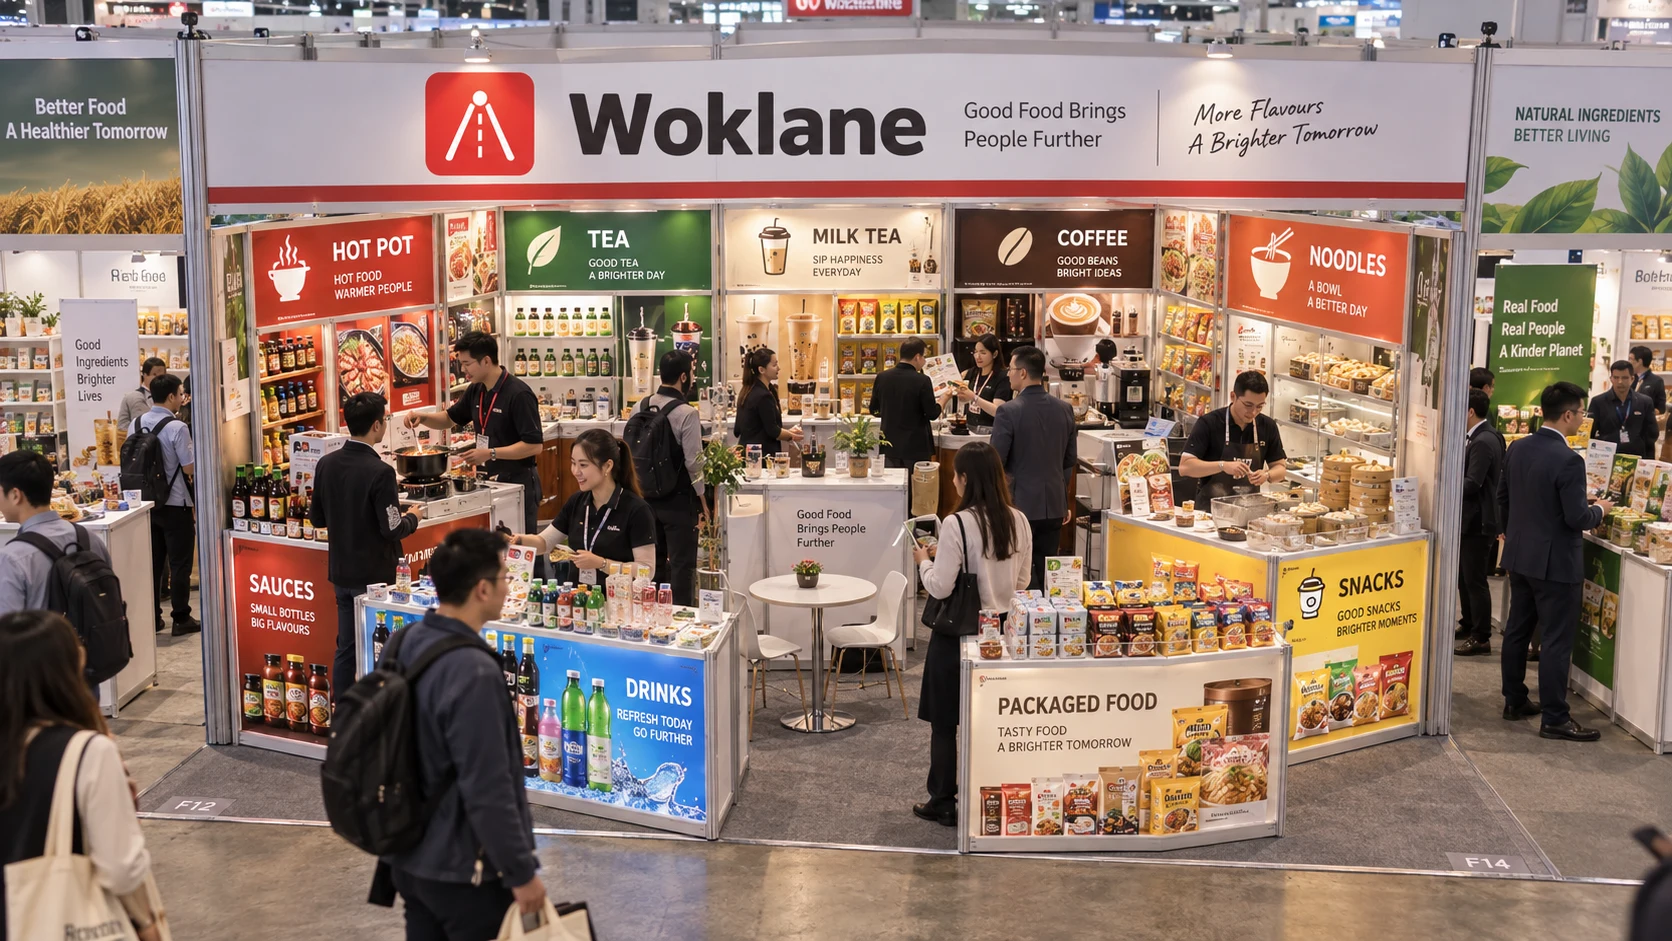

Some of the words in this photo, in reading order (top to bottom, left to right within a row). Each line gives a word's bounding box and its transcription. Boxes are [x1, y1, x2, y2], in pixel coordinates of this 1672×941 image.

[36, 98, 84, 114] Better
[89, 98, 126, 115] Food
[965, 102, 1012, 118] Good
[1020, 102, 1062, 118] Food
[1070, 102, 1126, 123] Brings
[1194, 103, 1242, 126] More
[1251, 98, 1323, 121] Flavours
[1516, 107, 1574, 121] NATURAL
[1578, 108, 1660, 123] INGREDIENTS
[6, 123, 17, 139] A
[21, 122, 89, 139] Healthier
[93, 123, 167, 139] Tomorrow
[569, 92, 926, 156] Woklane
[965, 130, 1027, 151] People
[1034, 130, 1102, 147] Further
[1188, 134, 1203, 154] A
[1210, 128, 1287, 157] Brighter
[1293, 123, 1378, 144] Tomorrow
[1514, 128, 1563, 142] BETTER
[1568, 129, 1610, 142] LIVING
[588, 230, 630, 248] TEA
[814, 228, 858, 244] MILK
[865, 228, 901, 244] TEA
[1058, 230, 1127, 246] COFFEE
[333, 239, 371, 261] HOT
[377, 235, 413, 257] POT
[589, 259, 617, 268] GOOD
[620, 259, 638, 268] TEA
[813, 255, 827, 264] SIP
[831, 255, 883, 264] HAPPINESS
[1057, 256, 1085, 266] GOOD
[1088, 256, 1118, 266] BEANS
[1310, 245, 1386, 277] NOODLES
[334, 273, 353, 285] HOT
[357, 270, 382, 282] FOOD
[589, 272, 596, 280] A
[599, 271, 644, 280] BRIGHTER
[647, 271, 665, 280] DAY
[813, 268, 861, 277] EVERYDAY
[1057, 269, 1092, 278] BRIGHT
[1095, 269, 1121, 278] IDEAS
[335, 285, 375, 299] WARMER
[378, 281, 412, 294] PEOPLE
[1308, 280, 1314, 291] A
[1317, 282, 1342, 296] BOWL
[1307, 297, 1313, 308] A
[1316, 298, 1347, 314] BETTER
[1350, 304, 1367, 317] DAY
[1503, 300, 1527, 313] Real
[1531, 299, 1558, 313] Food
[1502, 322, 1525, 335] Real
[1529, 321, 1565, 338] People
[75, 339, 100, 350] Good
[1499, 345, 1508, 358] A
[1511, 344, 1546, 357] Kinder
[1549, 343, 1583, 356] Planet
[76, 356, 128, 370] Ingredients
[77, 373, 115, 387] Brighter
[78, 391, 102, 402] Lives
[797, 509, 823, 519] Good
[827, 510, 851, 519] Food
[798, 524, 829, 535] Brings
[832, 524, 866, 535] People
[798, 538, 834, 548] Further
[250, 574, 314, 600] SAUCES
[1339, 570, 1403, 597] SNACKS
[251, 603, 277, 616] SMALL
[280, 607, 315, 622] BOTTLES
[1338, 607, 1364, 621] GOOD
[1367, 601, 1400, 616] SNACKS
[251, 617, 265, 628] BIG
[267, 620, 310, 635] FLAVOURS
[1337, 621, 1376, 637] BRIGHTER
[1379, 613, 1417, 629] MOMENTS
[626, 678, 691, 706] DRINKS
[999, 695, 1100, 715] PACKAGED
[1107, 693, 1157, 711] FOOD
[617, 708, 658, 725] REFRESH
[661, 716, 692, 730] TODAY
[634, 727, 647, 738] GO
[650, 729, 692, 745] FURTHER
[998, 727, 1032, 738] TASTY
[1037, 726, 1067, 736] FOOD
[998, 742, 1005, 752] A
[1009, 740, 1063, 752] BRIGHTER
[1066, 738, 1132, 750] TOMORROW
[175, 801, 216, 811] F12
[1465, 858, 1510, 869] F14
